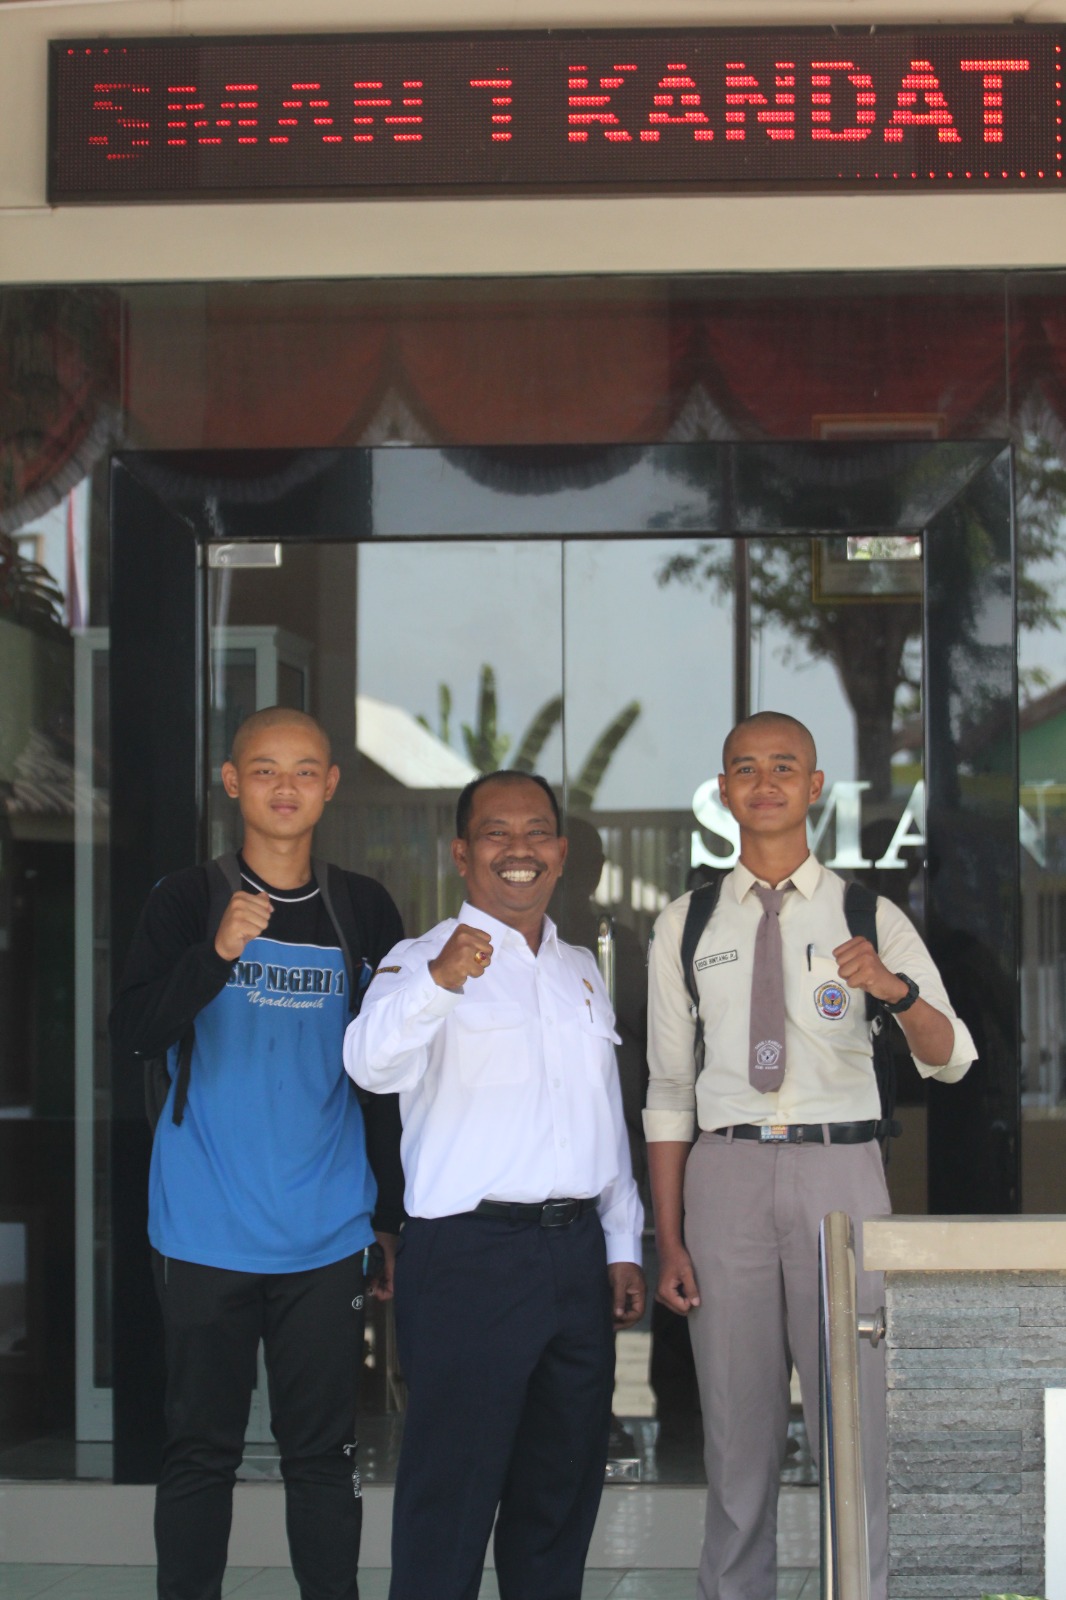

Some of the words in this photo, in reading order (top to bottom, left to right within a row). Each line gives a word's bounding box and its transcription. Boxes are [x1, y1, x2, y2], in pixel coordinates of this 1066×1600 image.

[89, 82, 423, 160] SMAN
[469, 67, 512, 140] 1
[568, 58, 1030, 143] KANDAT
[265, 964, 332, 994] NEGERI
[335, 970, 344, 996] 1
[247, 990, 324, 1009] Ngadiluwih
